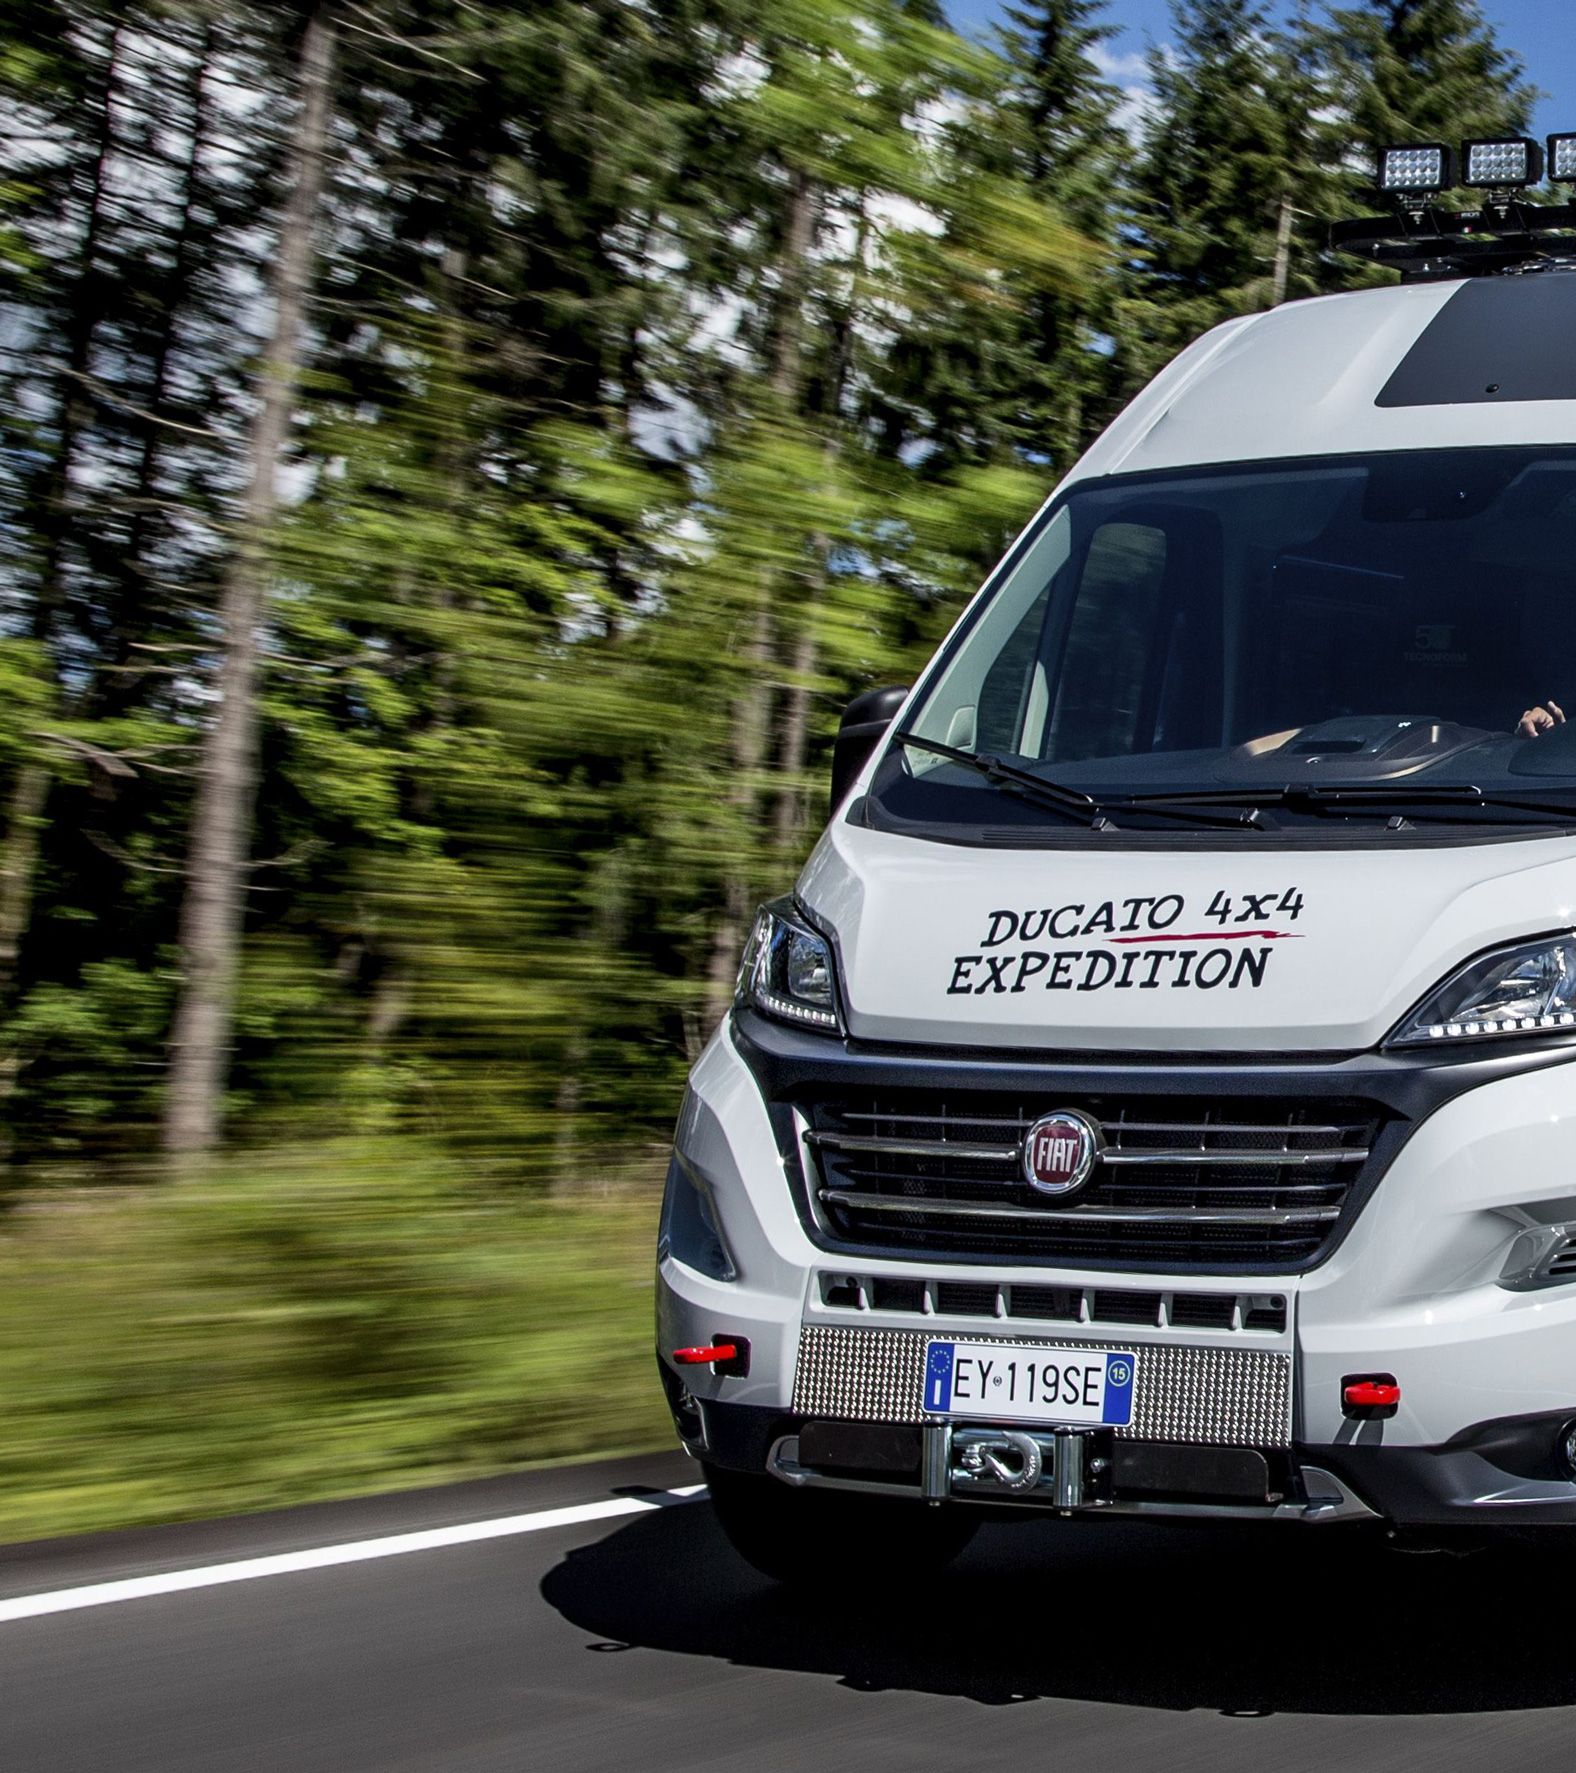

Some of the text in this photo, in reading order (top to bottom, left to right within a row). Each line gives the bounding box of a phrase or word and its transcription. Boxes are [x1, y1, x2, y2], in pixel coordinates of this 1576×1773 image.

[980, 894, 1185, 948] DUCATO
[946, 947, 1274, 995] EXPEDITION
[1037, 1137, 1078, 1172] FIAT
[953, 1358, 1102, 1406] EY 119SE
[1112, 1368, 1126, 1379] 15
